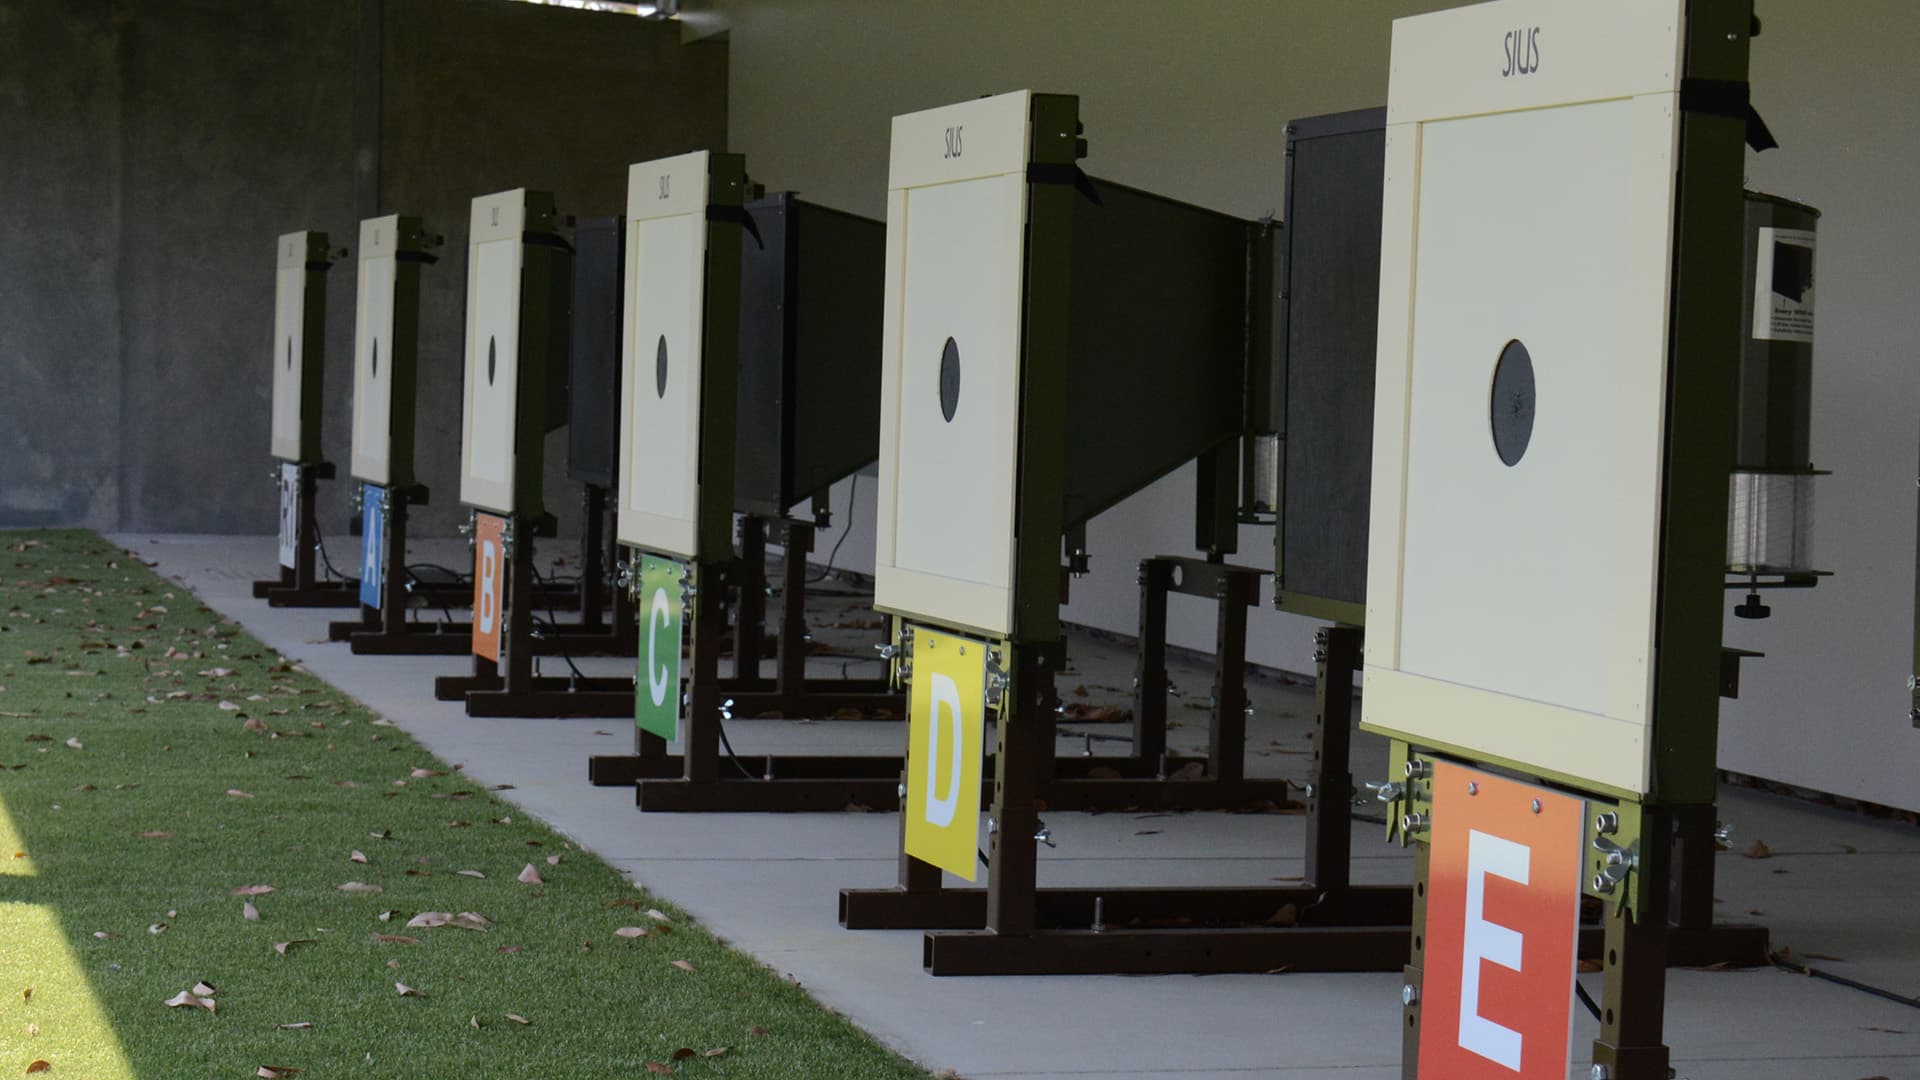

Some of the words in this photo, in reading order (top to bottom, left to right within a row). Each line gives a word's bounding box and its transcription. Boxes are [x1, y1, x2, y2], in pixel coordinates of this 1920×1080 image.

[1502, 26, 1540, 78] SIUS
[944, 125, 963, 160] SIUS
[364, 507, 376, 588] A
[480, 541, 495, 634] B
[648, 587, 670, 707] C
[925, 672, 962, 829] D
[1458, 828, 1531, 1073] E
